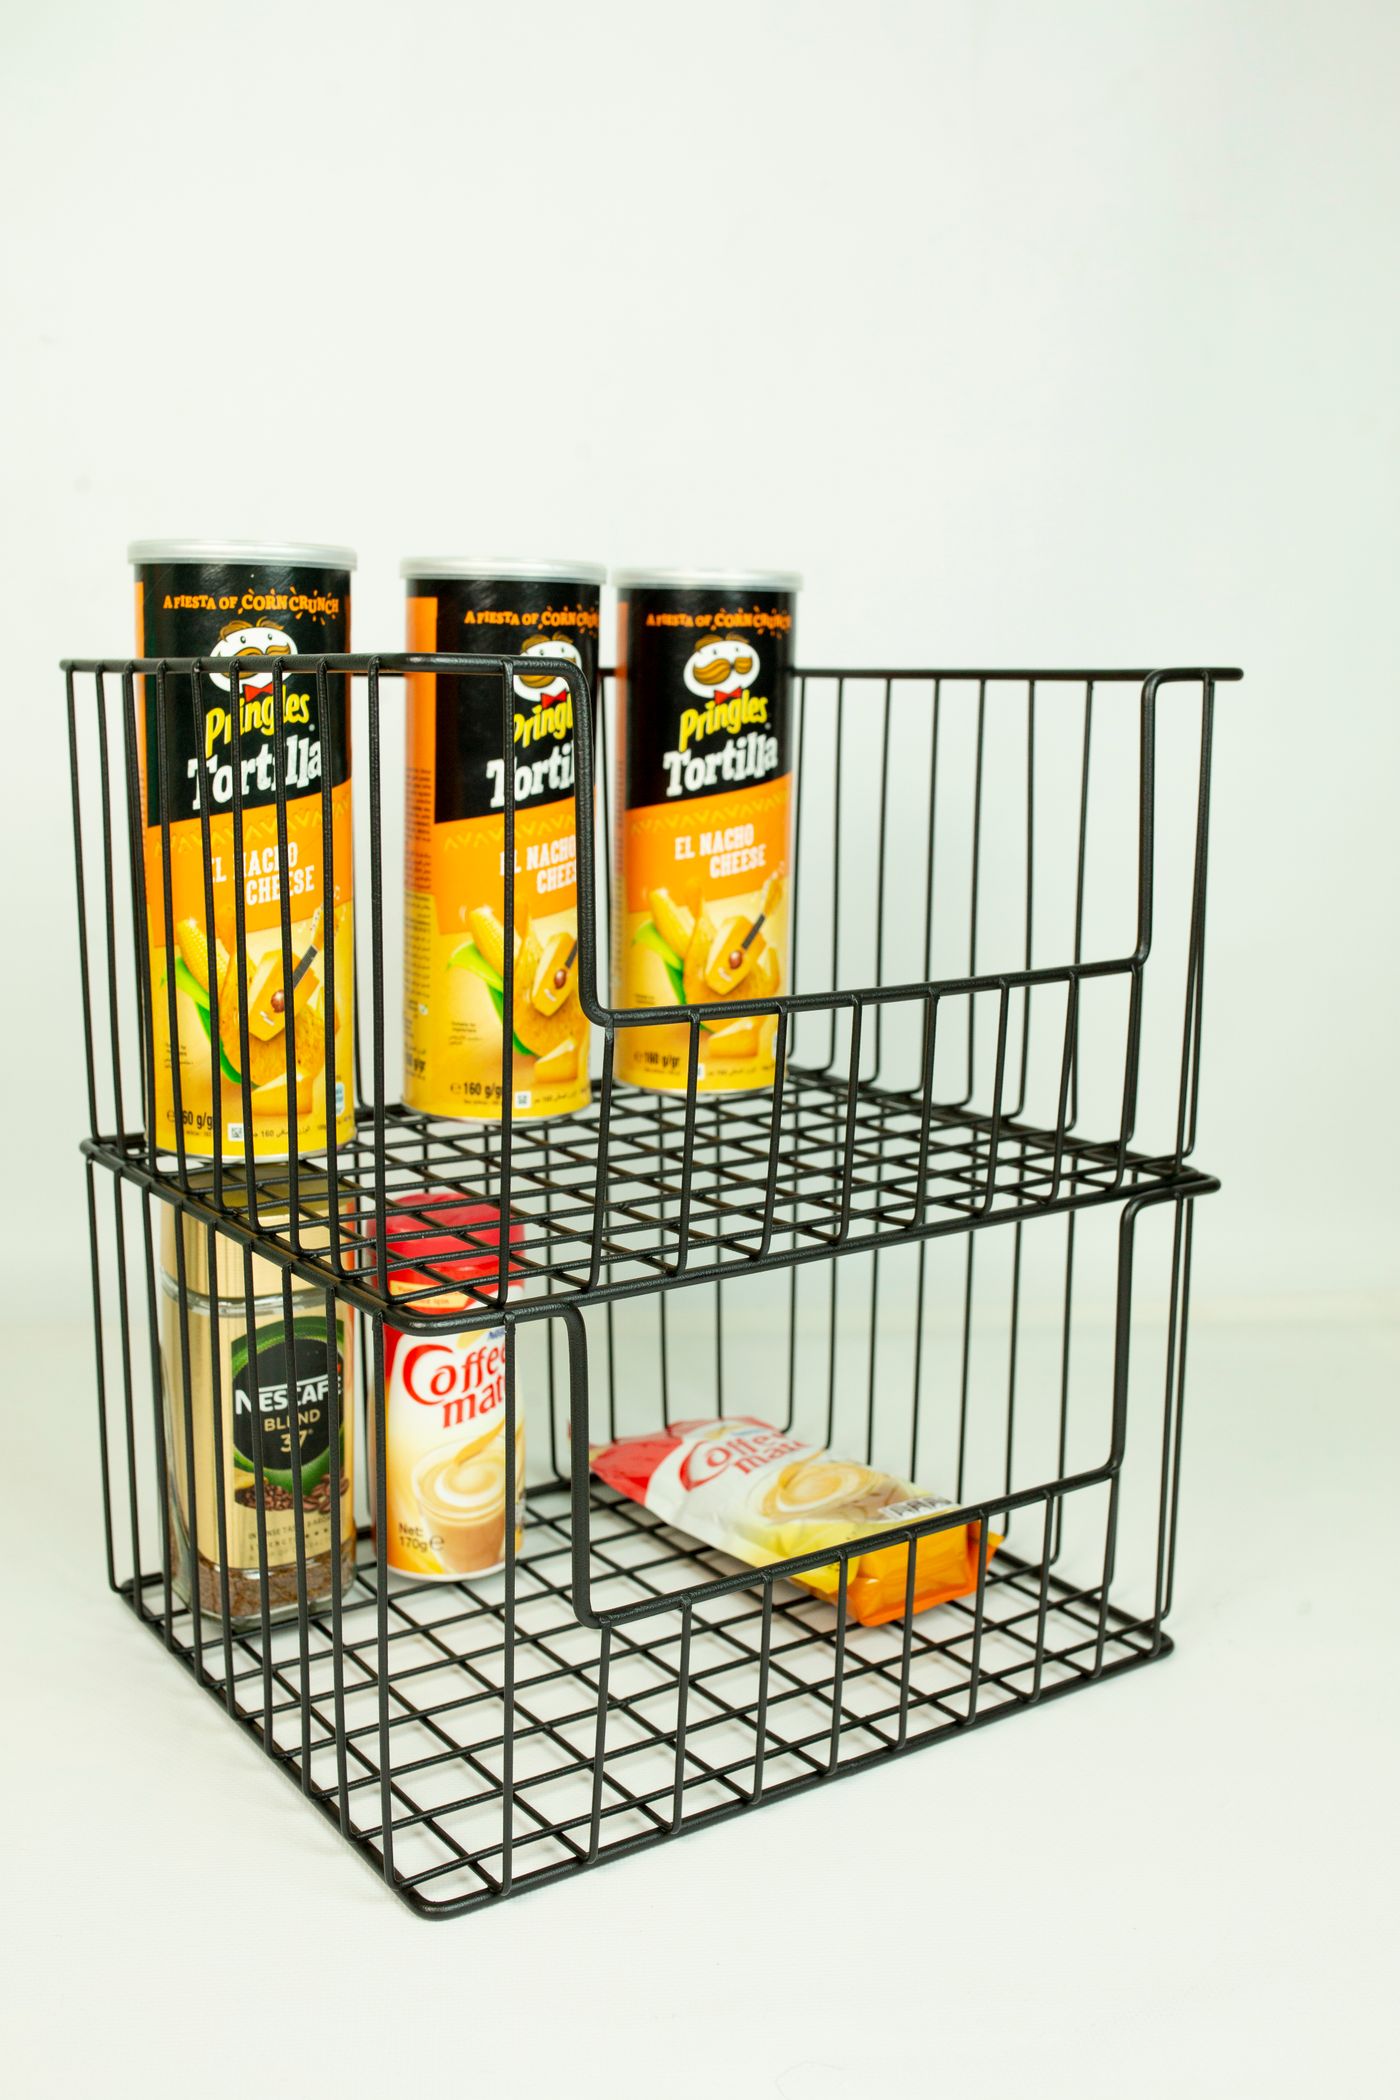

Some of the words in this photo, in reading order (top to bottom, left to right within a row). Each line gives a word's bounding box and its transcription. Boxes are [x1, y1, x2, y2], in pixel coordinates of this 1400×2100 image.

[163, 595, 173, 609] A
[173, 594, 217, 610] FIESTA
[218, 596, 238, 610] OF
[240, 594, 288, 611] CORN
[289, 594, 339, 615] CRUNCH
[464, 610, 476, 624] A
[477, 611, 520, 625] FIESTA
[521, 613, 539, 625] OF
[541, 611, 577, 626] CORN
[513, 692, 574, 748] Pringl
[679, 689, 768, 753] Pringles
[486, 740, 575, 808] Torti
[663, 731, 778, 797] Tortilla
[674, 835, 696, 861] EL
[699, 823, 755, 856] NACHO
[709, 843, 767, 879] CHEESE
[536, 858, 577, 894] CHEE
[182, 1109, 195, 1126] 60
[443, 1375, 505, 1429] mat
